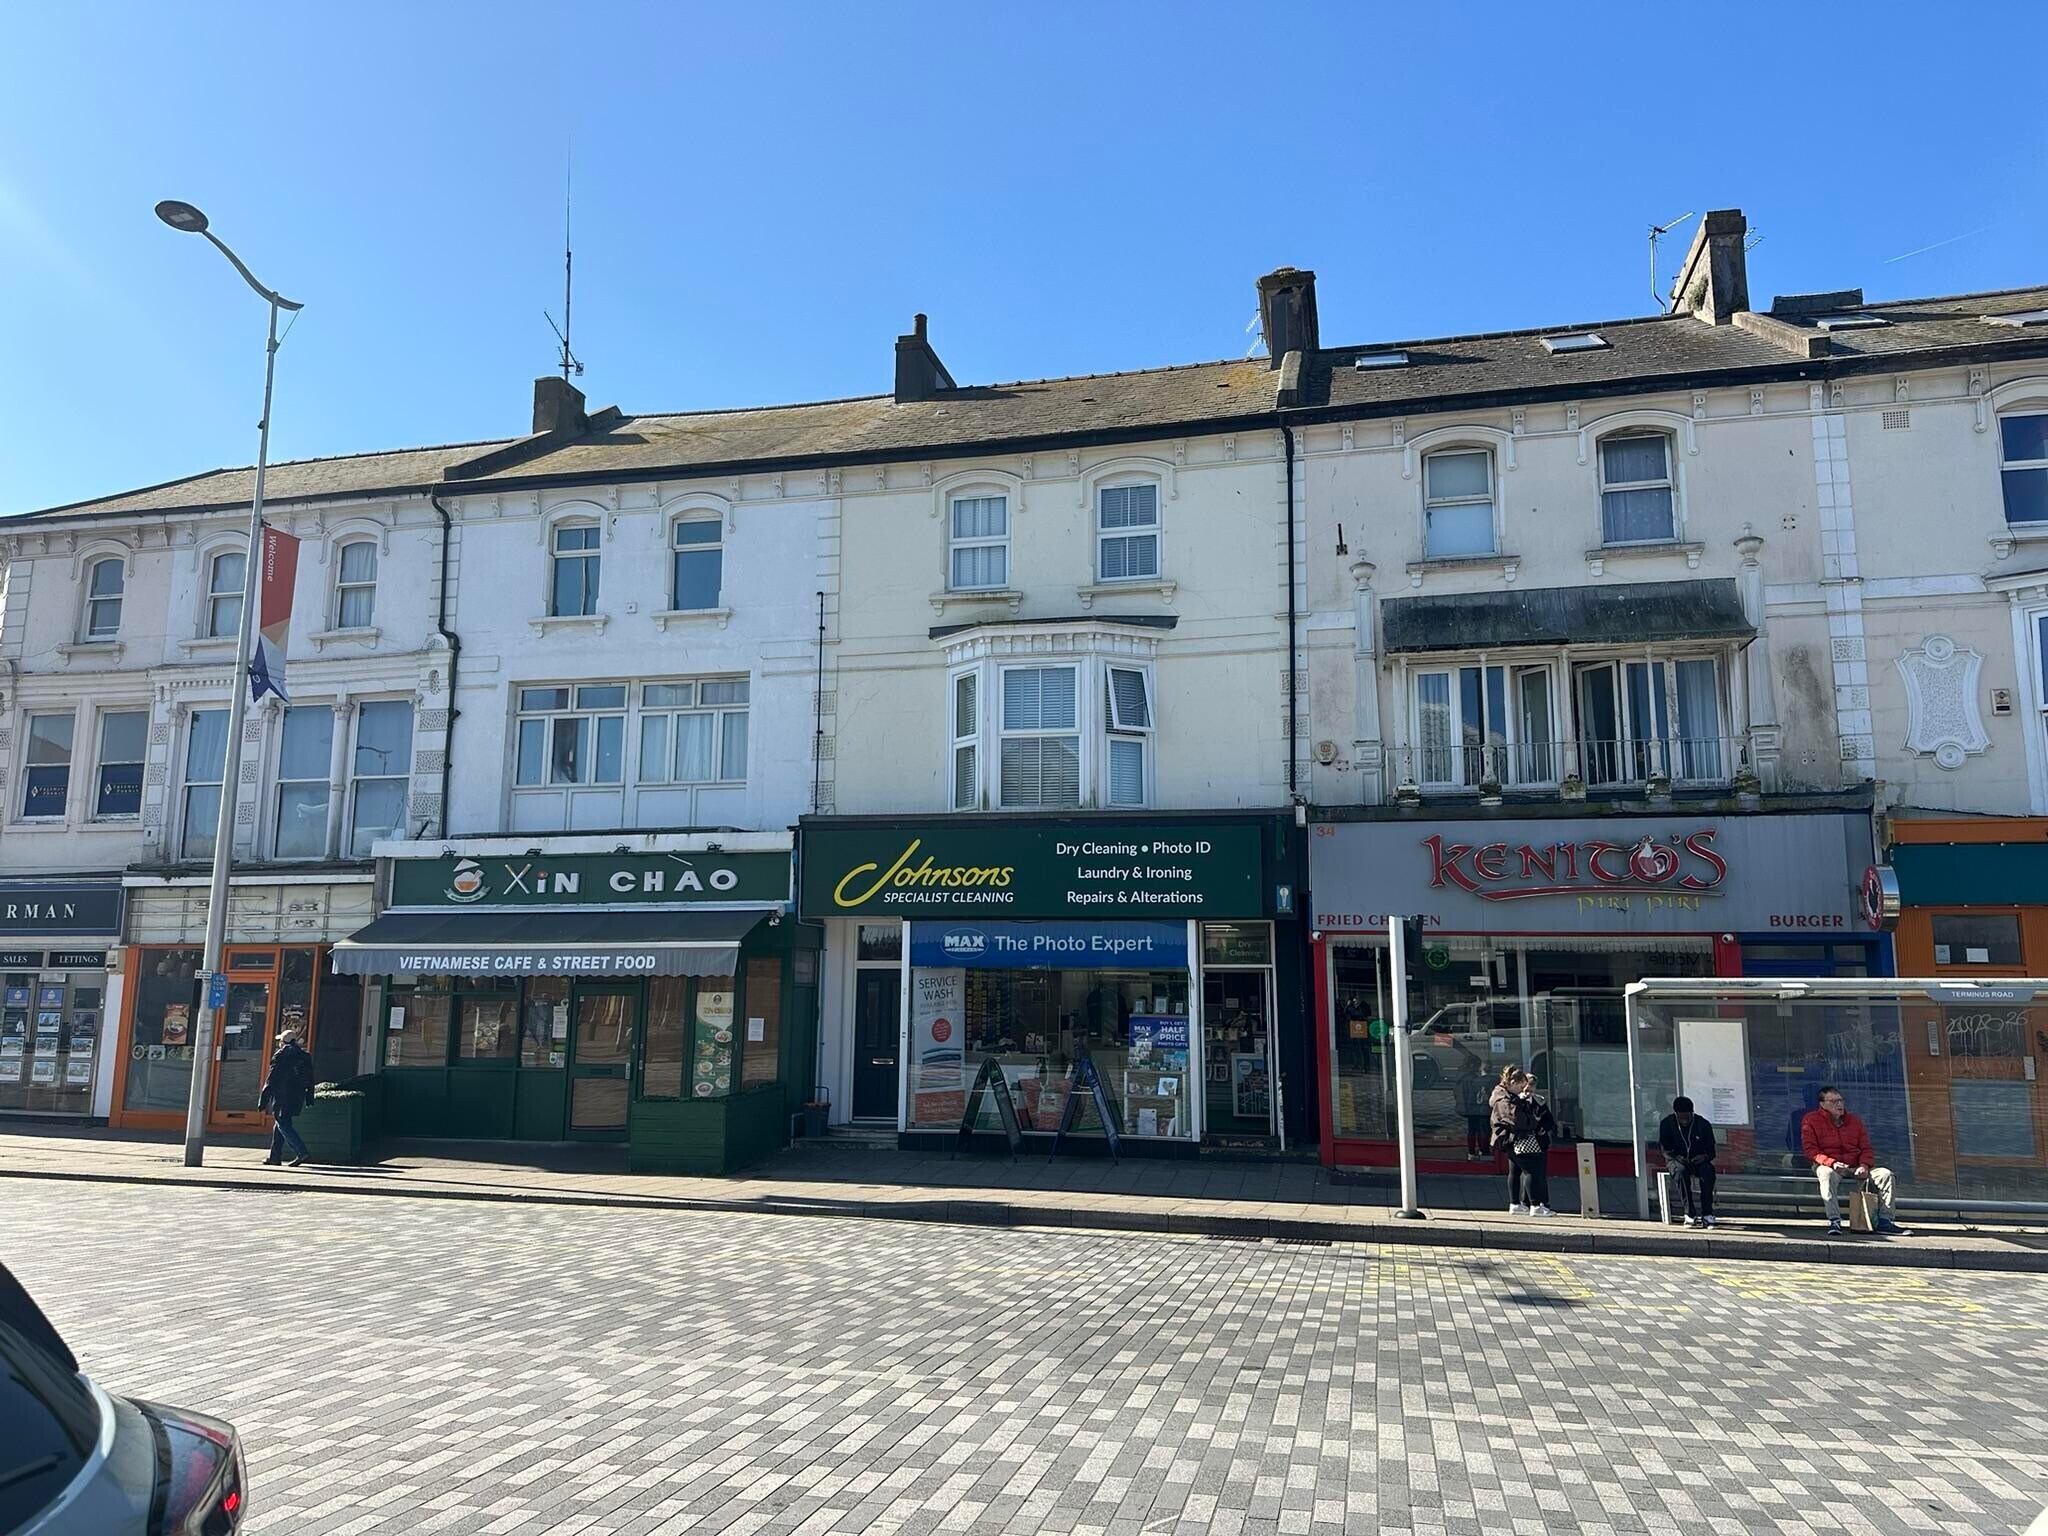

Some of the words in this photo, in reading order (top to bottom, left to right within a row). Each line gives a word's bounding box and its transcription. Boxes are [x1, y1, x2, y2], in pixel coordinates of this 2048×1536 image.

[267, 535, 277, 582] Welcome
[1316, 826, 1335, 837] 34
[1056, 842, 1080, 857] Dry
[1082, 842, 1137, 857] Cleaning
[1153, 842, 1192, 854] Photo
[1195, 842, 1211, 854] ID
[833, 838, 1014, 907] Johnsons
[1078, 866, 1129, 880] Laundry
[1132, 866, 1143, 879] &
[1146, 866, 1192, 880] Ironing
[884, 892, 950, 903] SPECIALIST
[952, 892, 1014, 903] CLEANING
[1067, 891, 1114, 905] Repairs
[1117, 891, 1128, 903] &
[1130, 890, 1203, 903] Alterations
[6, 904, 76, 919] RMAN
[1577, 896, 1630, 916] PIRI
[1646, 896, 1700, 917] PIRI
[1318, 914, 1363, 926] FRIED
[1369, 914, 1441, 926] CHEN
[1770, 915, 1843, 927] BURGER
[944, 935, 985, 947] MAX
[994, 936, 1028, 951] The
[1034, 936, 1086, 951] Photo
[1092, 936, 1153, 955] Expert
[3, 955, 28, 964] SALES
[59, 955, 98, 964] LETTINGS
[400, 956, 489, 970] VIETNAMESE
[494, 956, 533, 970] CAFE
[537, 957, 547, 970] &
[552, 956, 610, 970] STREET
[615, 955, 657, 970] FOOD
[919, 975, 958, 989] SERVICE
[923, 988, 954, 1001] WASH
[1161, 1026, 1185, 1034] HALF
[1160, 1033, 1187, 1041] PRICE
